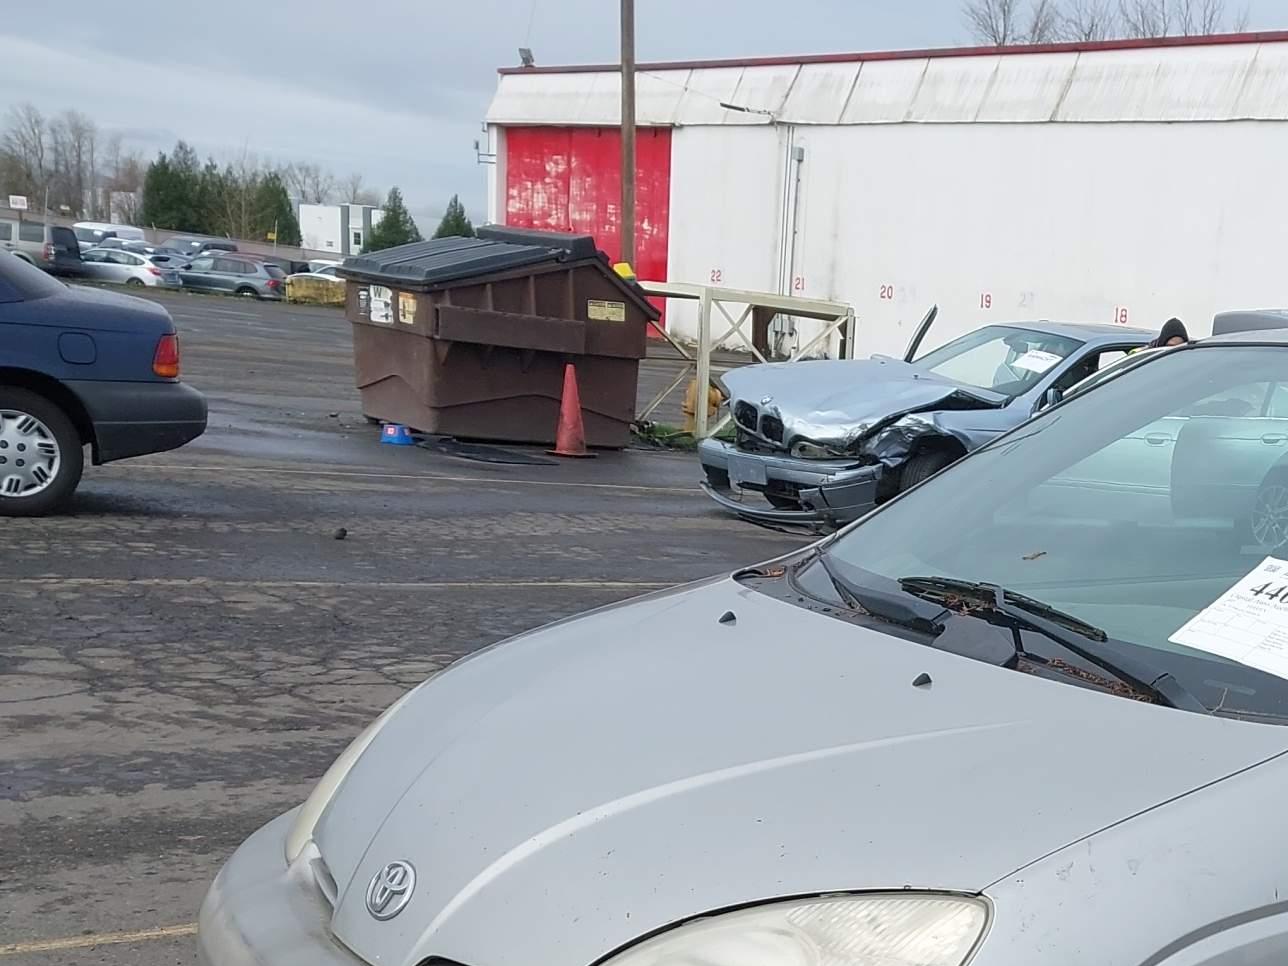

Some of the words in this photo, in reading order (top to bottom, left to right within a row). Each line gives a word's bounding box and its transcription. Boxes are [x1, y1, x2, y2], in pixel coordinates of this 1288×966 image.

[711, 269, 721, 282] 22
[795, 277, 805, 290] 21
[880, 284, 893, 299] 20
[980, 293, 992, 309] 19
[1114, 306, 1128, 324] 18
